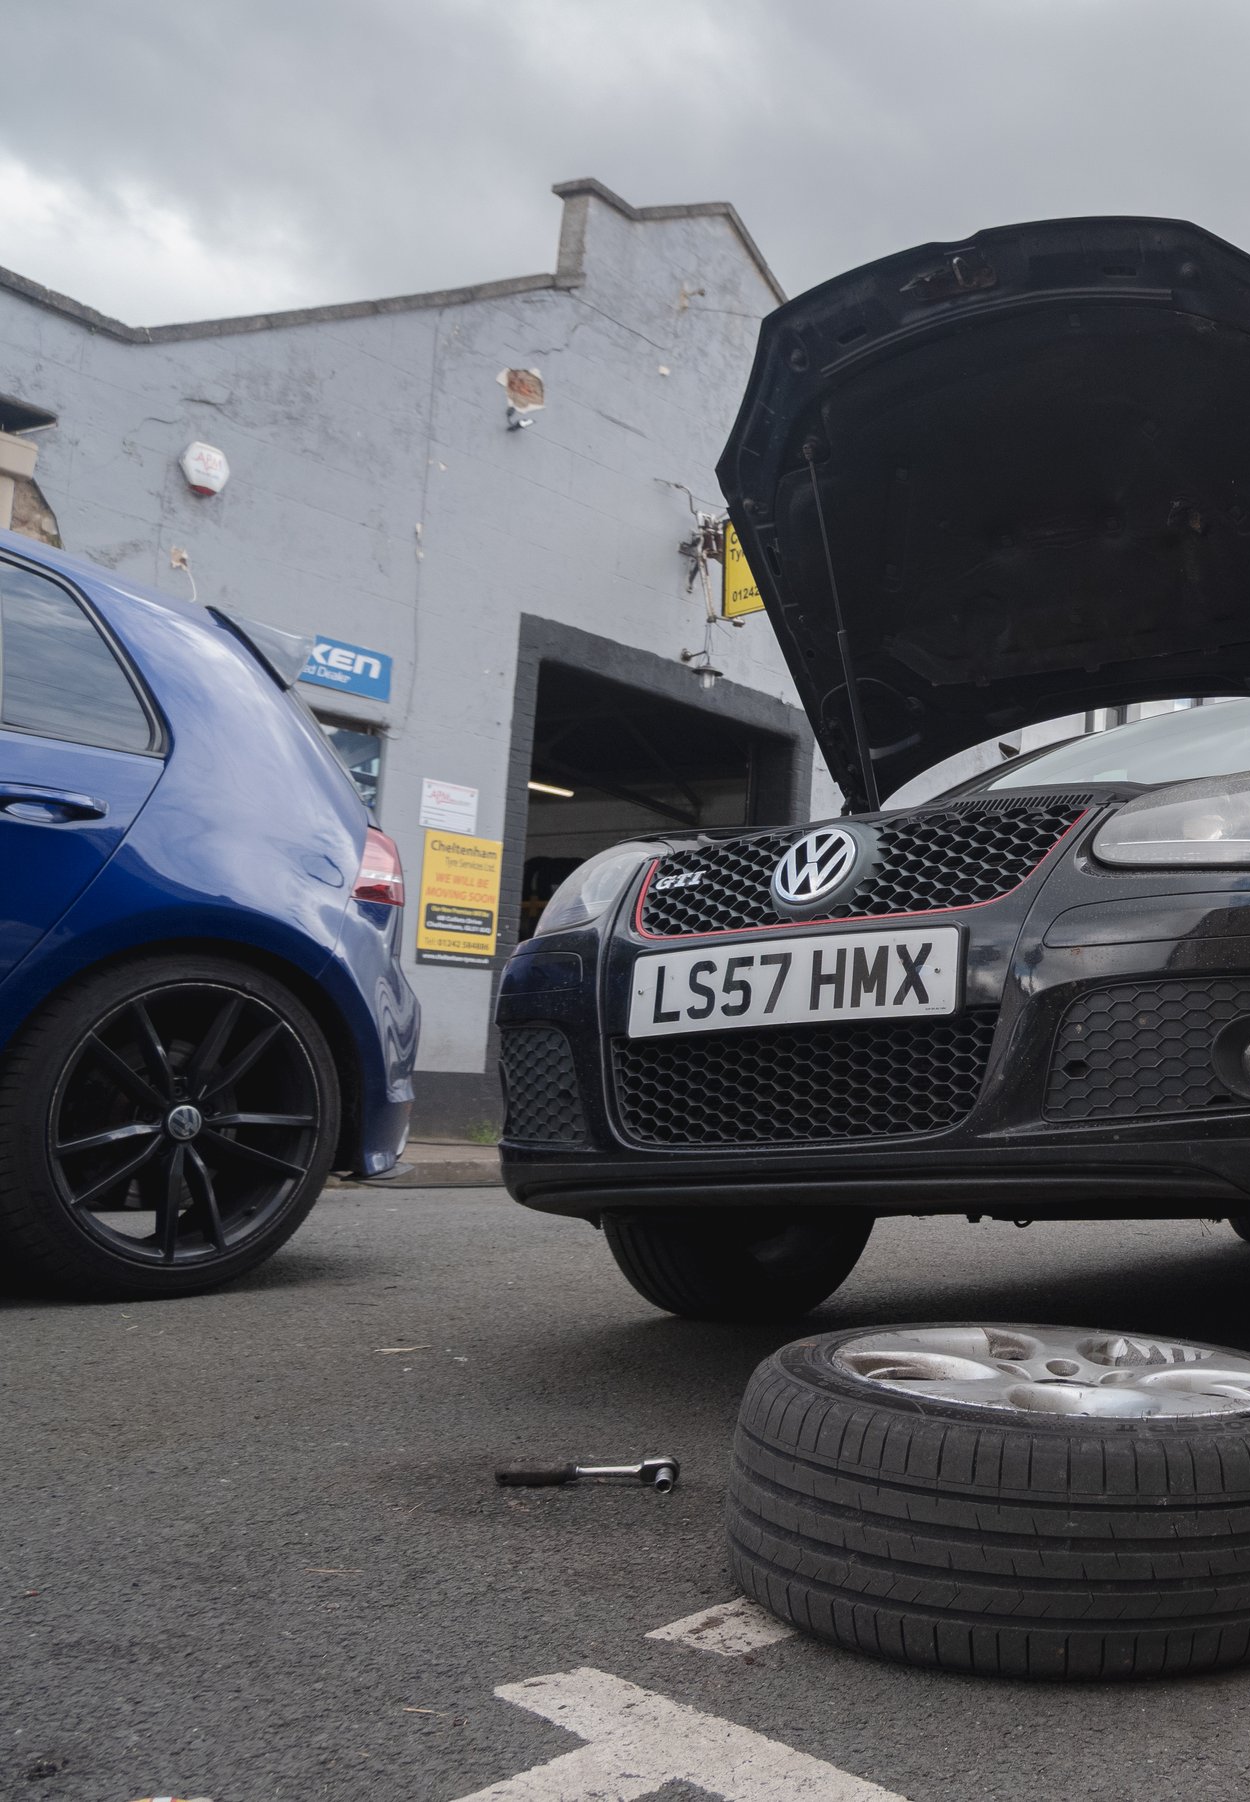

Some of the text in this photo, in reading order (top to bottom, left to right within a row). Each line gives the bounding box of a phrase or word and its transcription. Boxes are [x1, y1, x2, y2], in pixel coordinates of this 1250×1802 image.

[430, 839, 498, 859] Cheltenham
[655, 870, 707, 890] GTI
[426, 886, 466, 901] MOVING
[653, 942, 932, 1025] LS57 HMX
